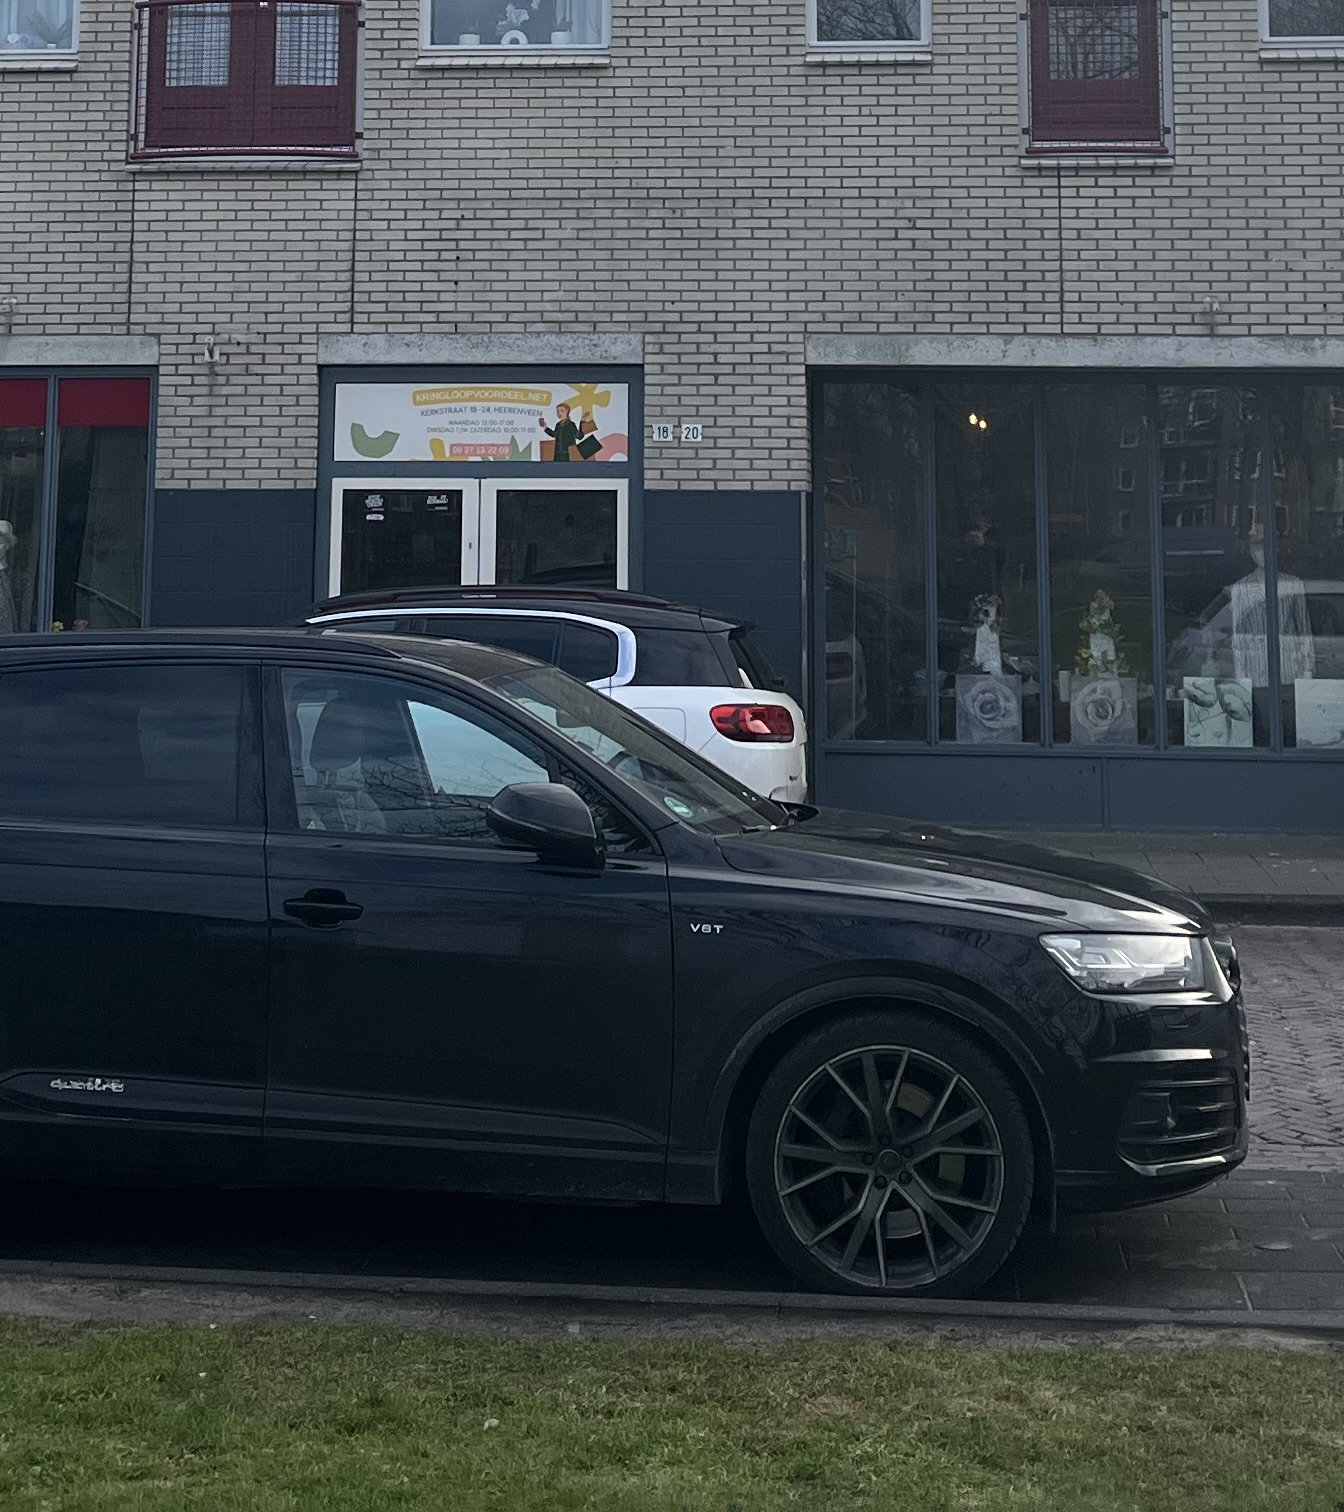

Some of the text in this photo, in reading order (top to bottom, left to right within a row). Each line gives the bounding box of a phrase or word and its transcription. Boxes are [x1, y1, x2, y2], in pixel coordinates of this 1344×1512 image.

[415, 390, 549, 402] KRINGLOOPVOORDEEL.NET
[420, 406, 467, 417] KERKSTRAAT
[493, 406, 543, 417] HEERENVEEN
[657, 426, 699, 439] 18 20
[464, 445, 474, 454] 27
[487, 445, 498, 454] 22
[689, 923, 725, 934] V8T
